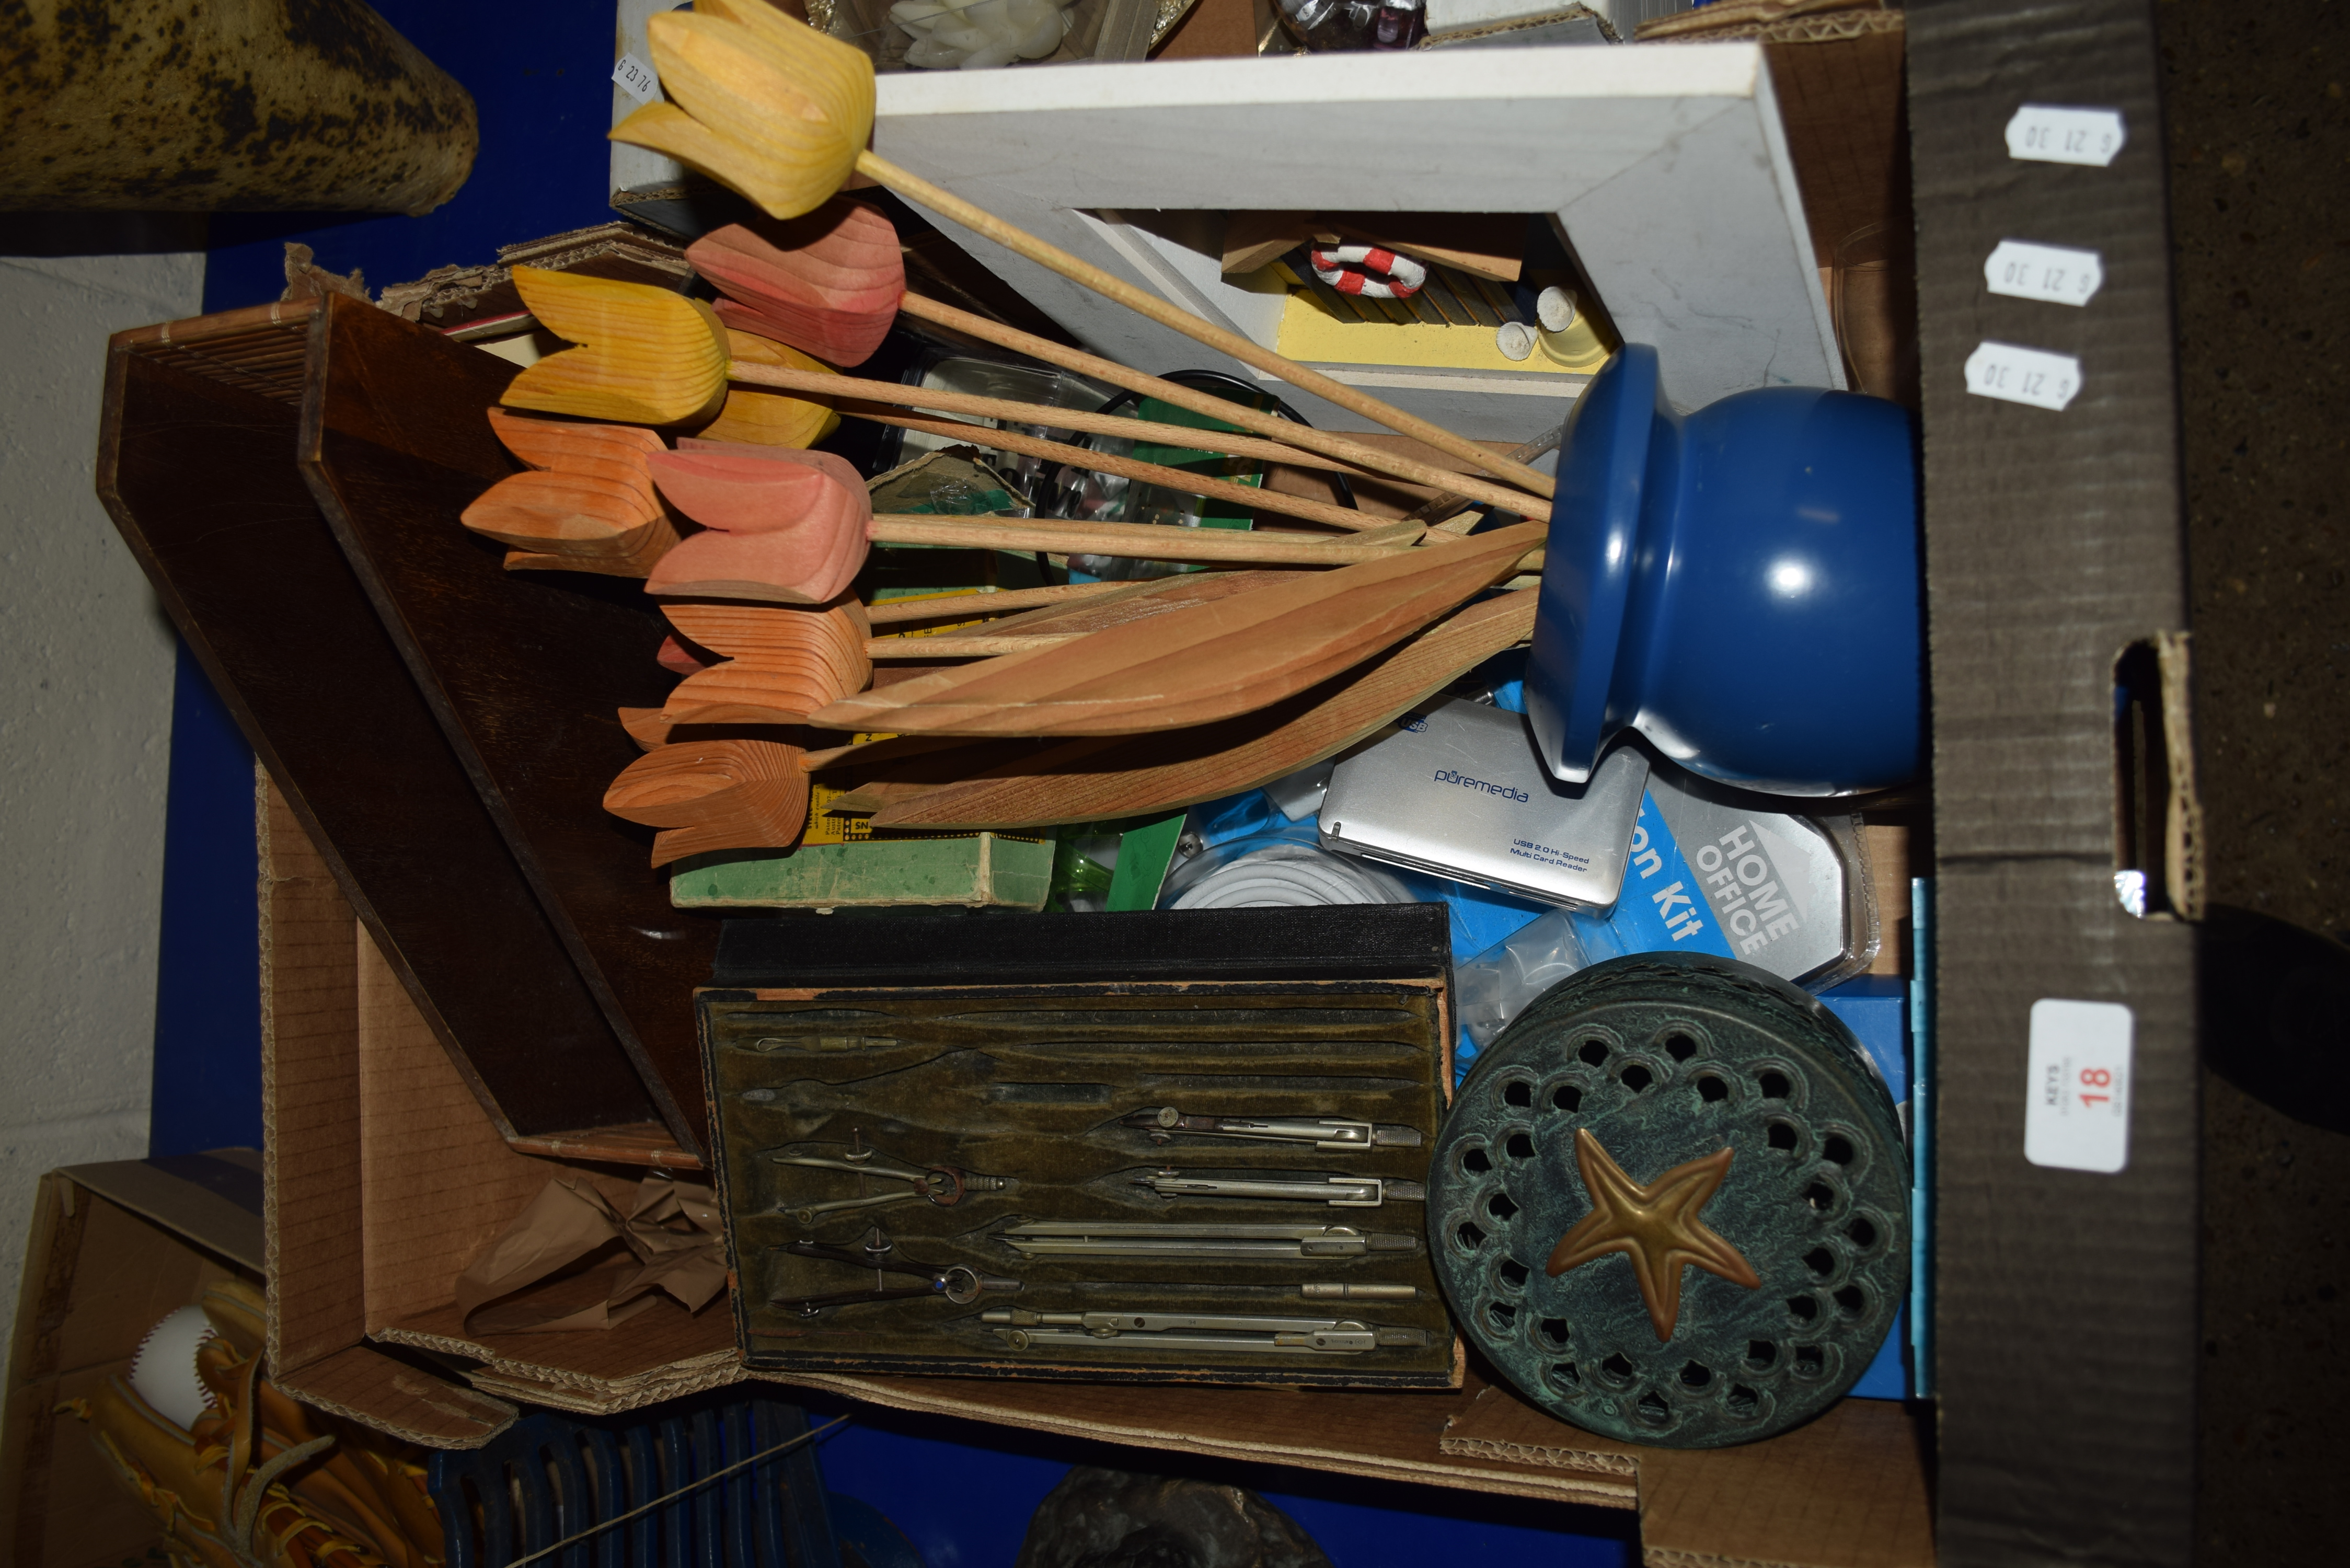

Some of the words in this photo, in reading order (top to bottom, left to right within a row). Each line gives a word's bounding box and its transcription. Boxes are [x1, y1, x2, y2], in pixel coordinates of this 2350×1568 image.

[626, 65, 638, 82] 23
[637, 75, 651, 92] 76
[2025, 125, 2051, 151] 30
[2065, 129, 2088, 152] 21
[2005, 261, 2028, 287] 30
[2044, 267, 2066, 291] 21
[1984, 364, 2009, 389] 30
[2022, 372, 2046, 396] 21
[1400, 718, 1428, 732] USB
[1434, 769, 1529, 804] puremedia
[1510, 848, 1532, 858] Multi
[1533, 854, 1554, 864] Card
[1556, 860, 1587, 872] Reader
[1513, 838, 1534, 849] USB
[1535, 845, 1549, 853] 2.0
[1550, 849, 1589, 864] Hi-Speed
[1719, 825, 1801, 941] HOME
[1652, 881, 1704, 942] Kit
[1696, 845, 1768, 955] OFFICE
[2045, 1064, 2060, 1106] KEYS
[2079, 1068, 2113, 1109] 18
